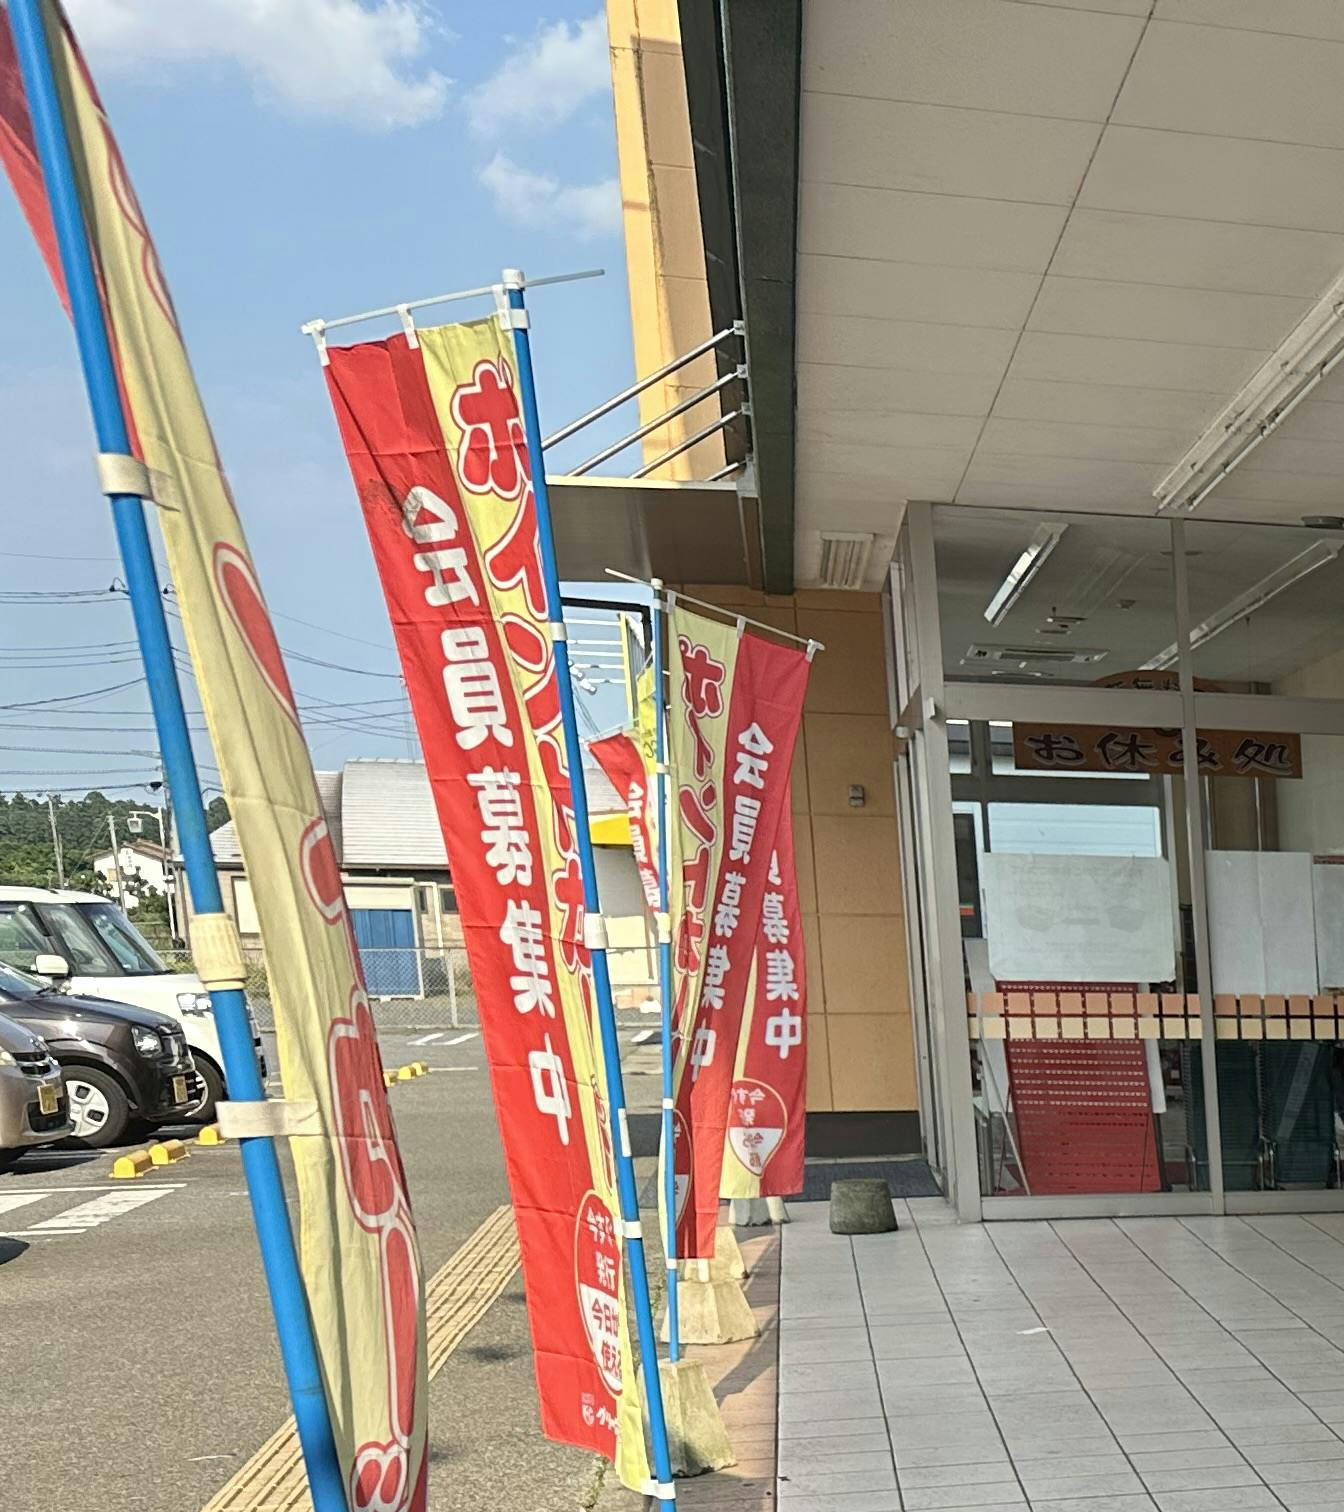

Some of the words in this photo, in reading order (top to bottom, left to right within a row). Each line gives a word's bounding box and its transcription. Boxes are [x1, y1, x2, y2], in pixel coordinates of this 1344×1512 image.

[401, 484, 572, 1146] 会員募集中
[1028, 731, 1294, 775] お休み処
